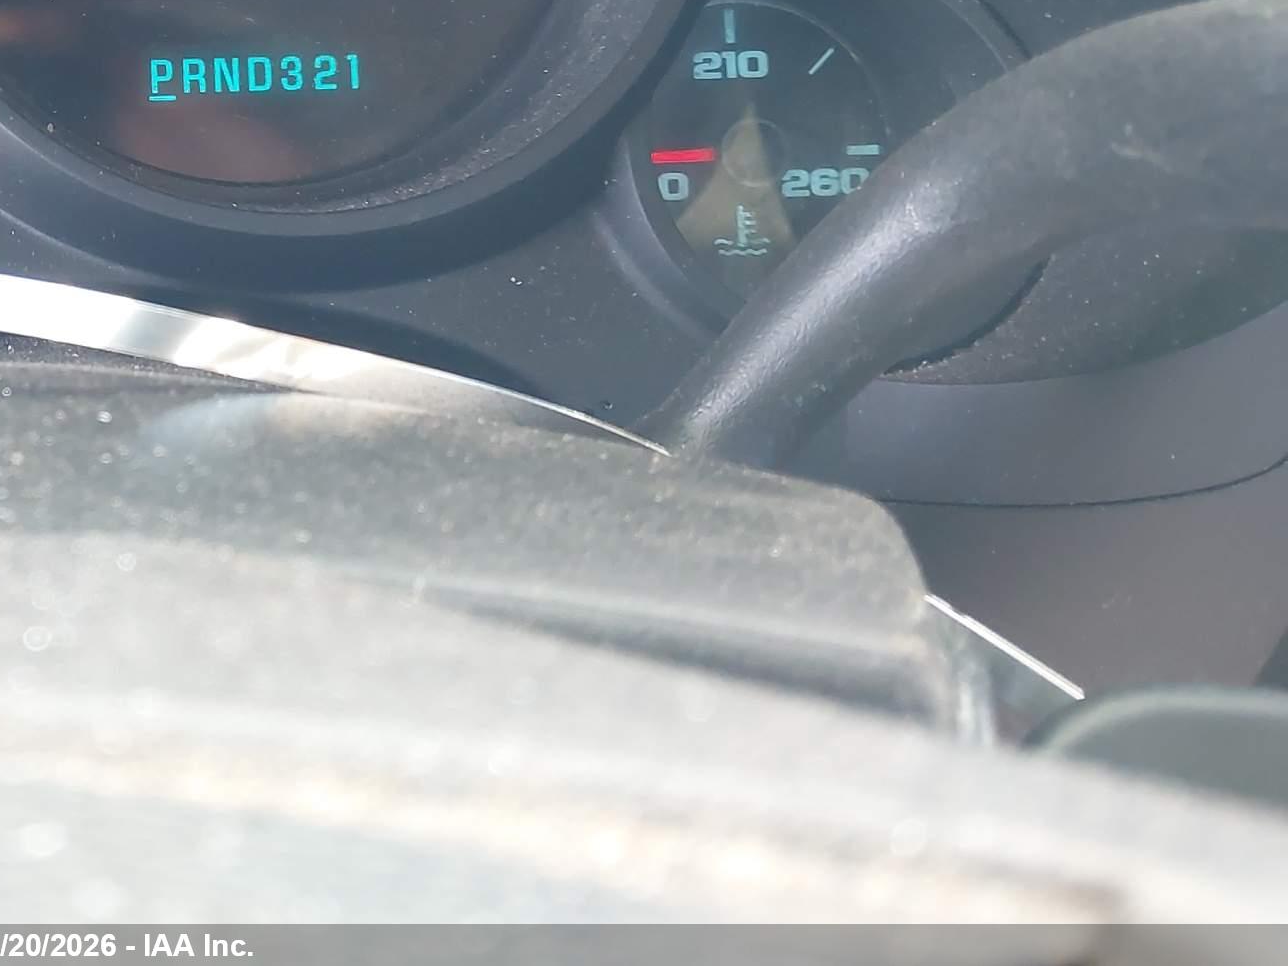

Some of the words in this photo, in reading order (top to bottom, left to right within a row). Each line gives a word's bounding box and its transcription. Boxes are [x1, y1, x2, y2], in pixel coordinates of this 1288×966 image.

[693, 50, 768, 79] 210
[658, 173, 689, 201] 0
[782, 167, 870, 197] 260
